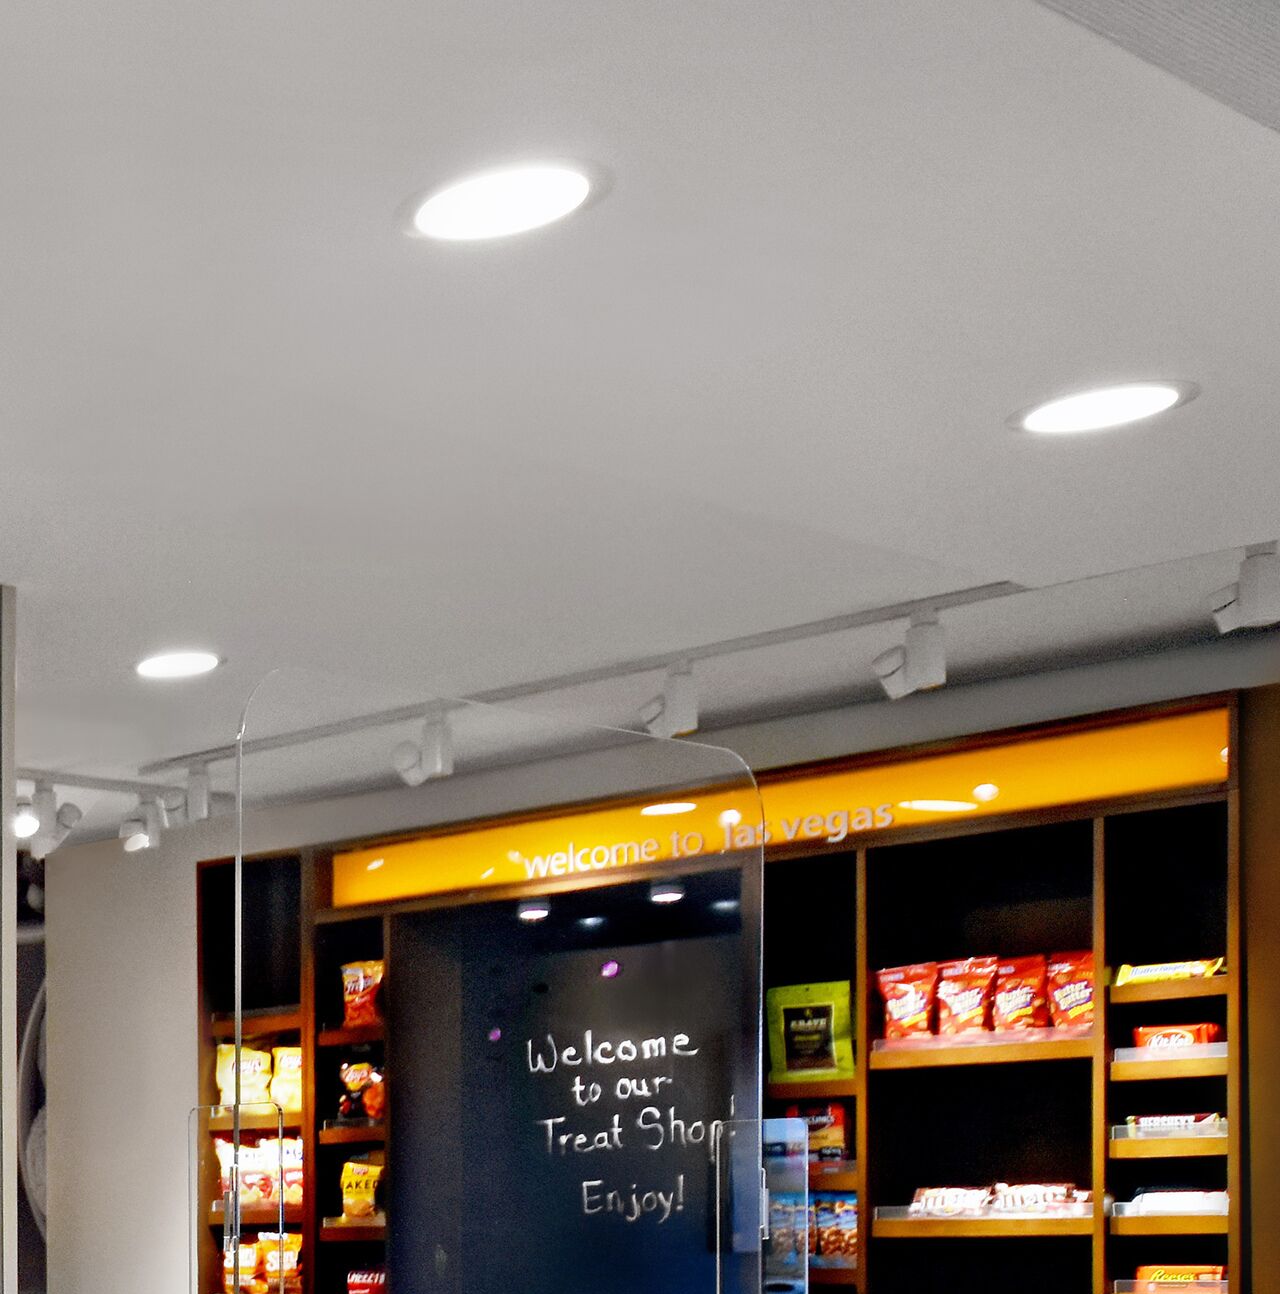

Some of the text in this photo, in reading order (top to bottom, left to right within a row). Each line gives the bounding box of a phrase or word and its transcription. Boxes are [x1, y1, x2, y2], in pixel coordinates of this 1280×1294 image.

[523, 842, 660, 880] welcome
[670, 831, 703, 856] to
[781, 802, 894, 842] vegas
[527, 1029, 700, 1073] Welcome
[571, 1075, 673, 1106] to our
[537, 1113, 624, 1154] Treat
[582, 1173, 685, 1224] Enjoy!
